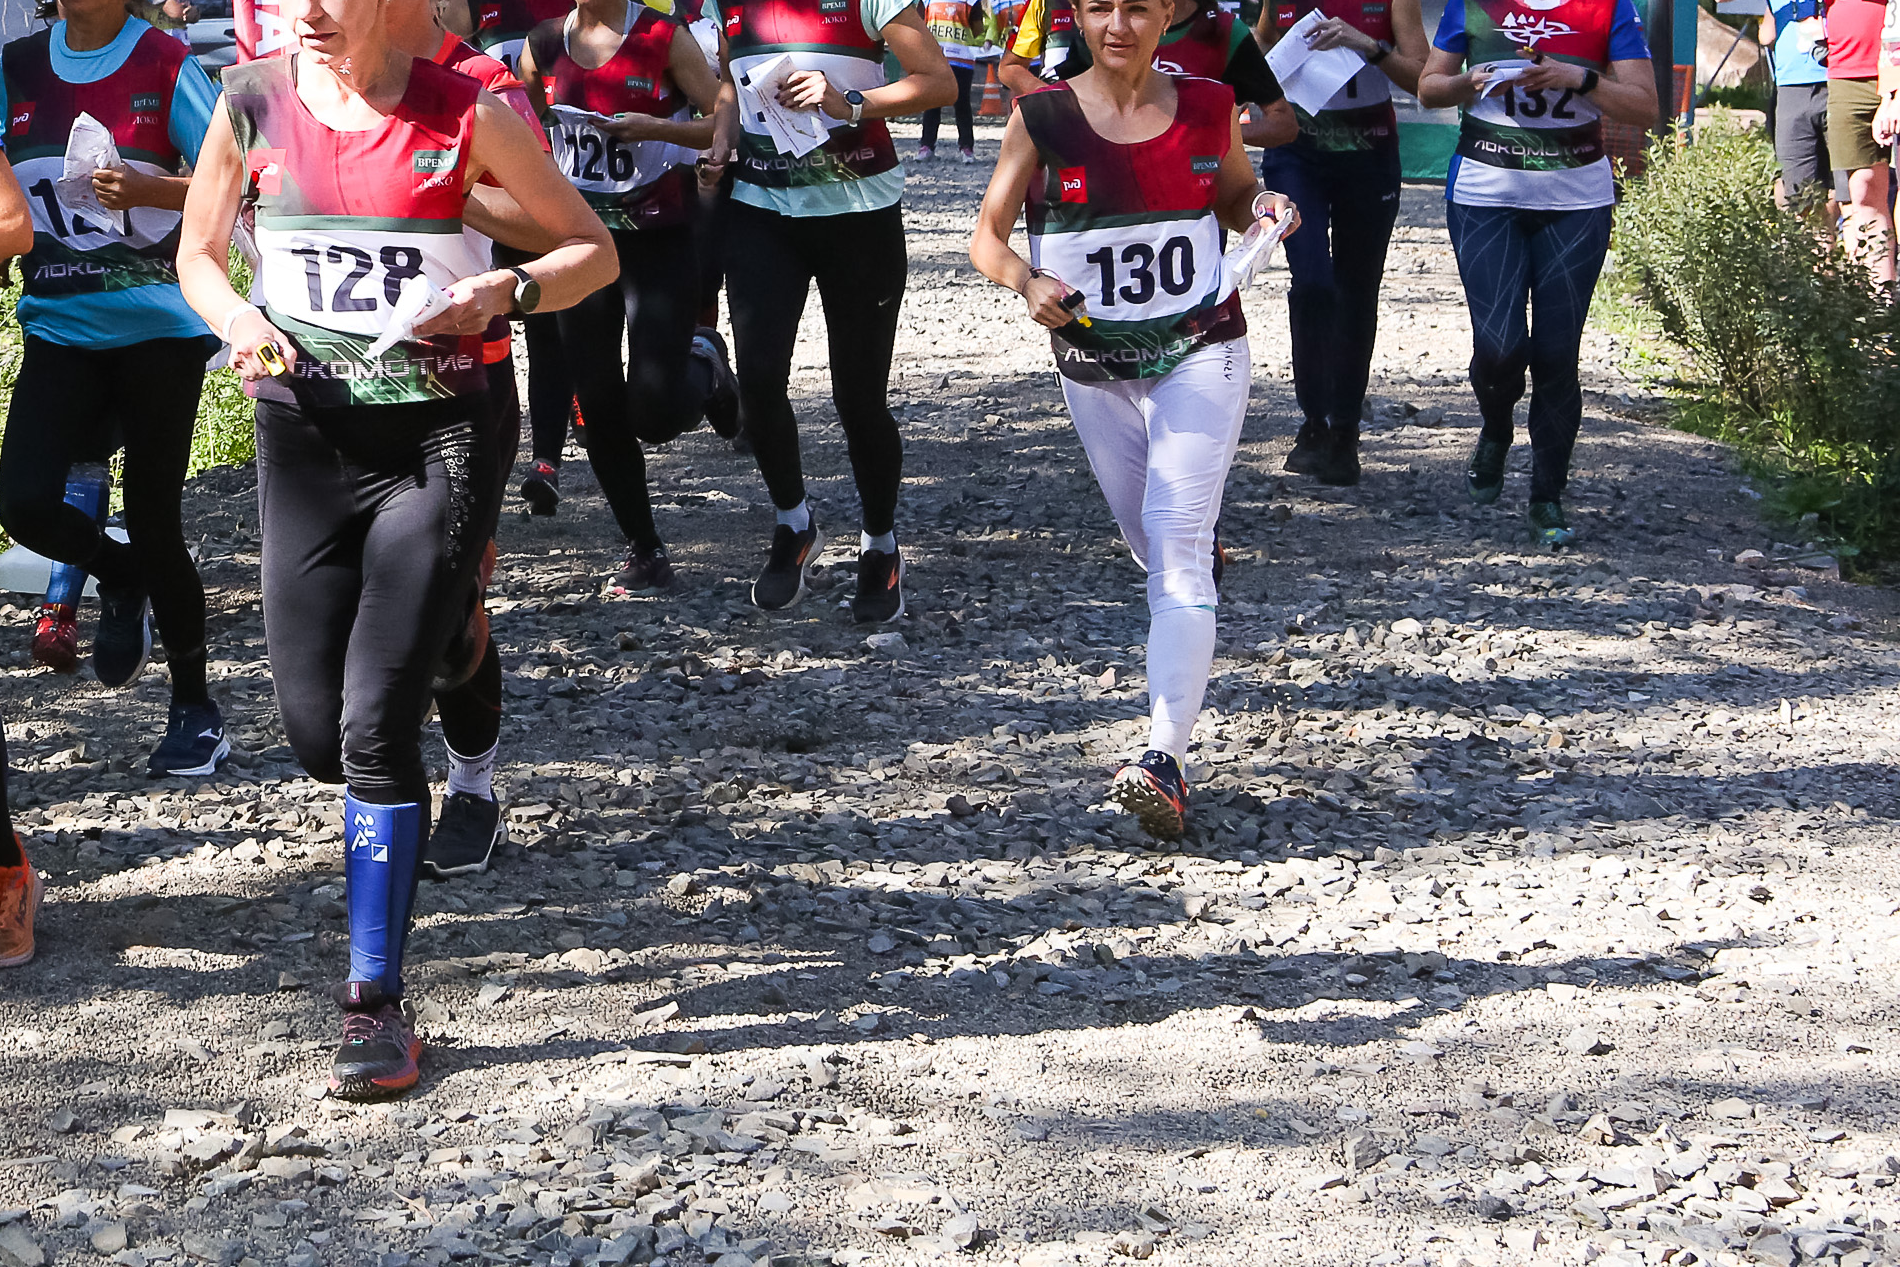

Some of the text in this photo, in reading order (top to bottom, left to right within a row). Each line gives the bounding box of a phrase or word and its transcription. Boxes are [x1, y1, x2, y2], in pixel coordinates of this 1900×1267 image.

[821, 15, 848, 25] ЛОКО
[1504, 83, 1576, 120] 132
[1299, 125, 1389, 137] КОМОТИВ
[564, 133, 636, 182] 126
[417, 175, 454, 189] ЛОКО
[290, 244, 427, 313] 128
[1085, 235, 1197, 307] 130
[294, 354, 474, 380] ОКОМОТИВ
